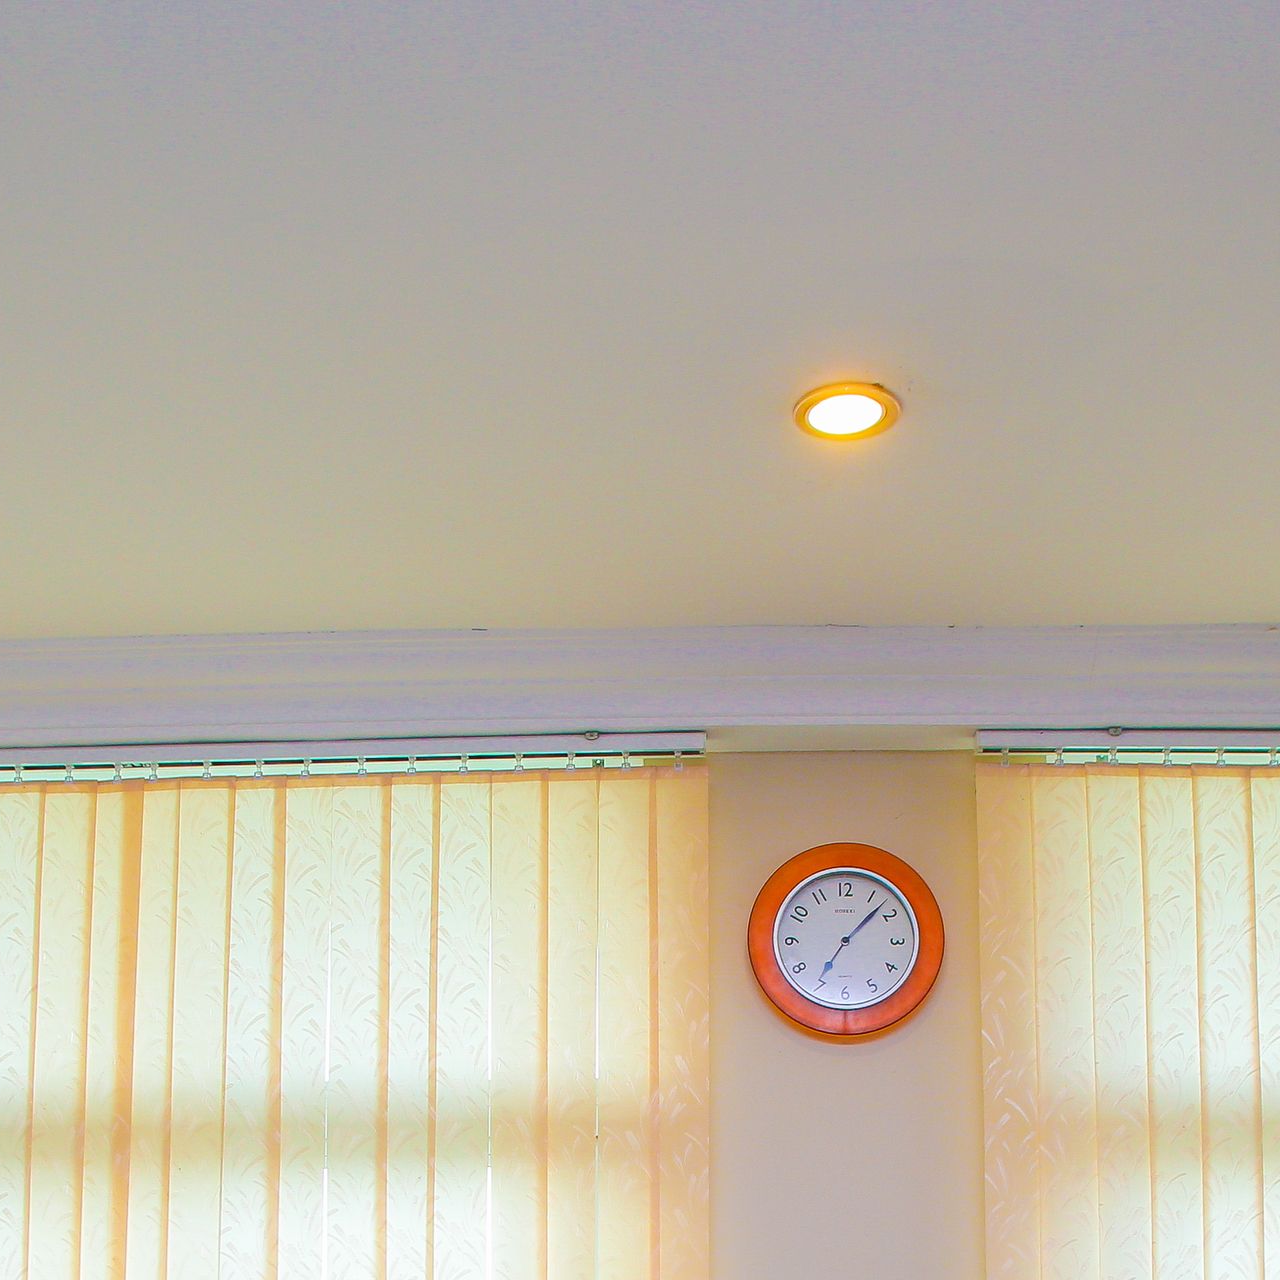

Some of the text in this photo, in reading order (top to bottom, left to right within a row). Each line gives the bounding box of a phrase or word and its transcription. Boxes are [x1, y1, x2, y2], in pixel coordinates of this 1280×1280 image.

[812, 888, 827, 904] 11
[838, 882, 853, 897] 12
[867, 890, 876, 903] 1
[790, 905, 808, 923] 10
[882, 908, 897, 922] 2
[785, 936, 799, 946] 9
[890, 937, 905, 946] 3
[792, 962, 806, 974] 8
[885, 961, 898, 973] 4
[813, 978, 826, 992] 7
[866, 978, 878, 993] 5
[841, 985, 850, 1000] 6
